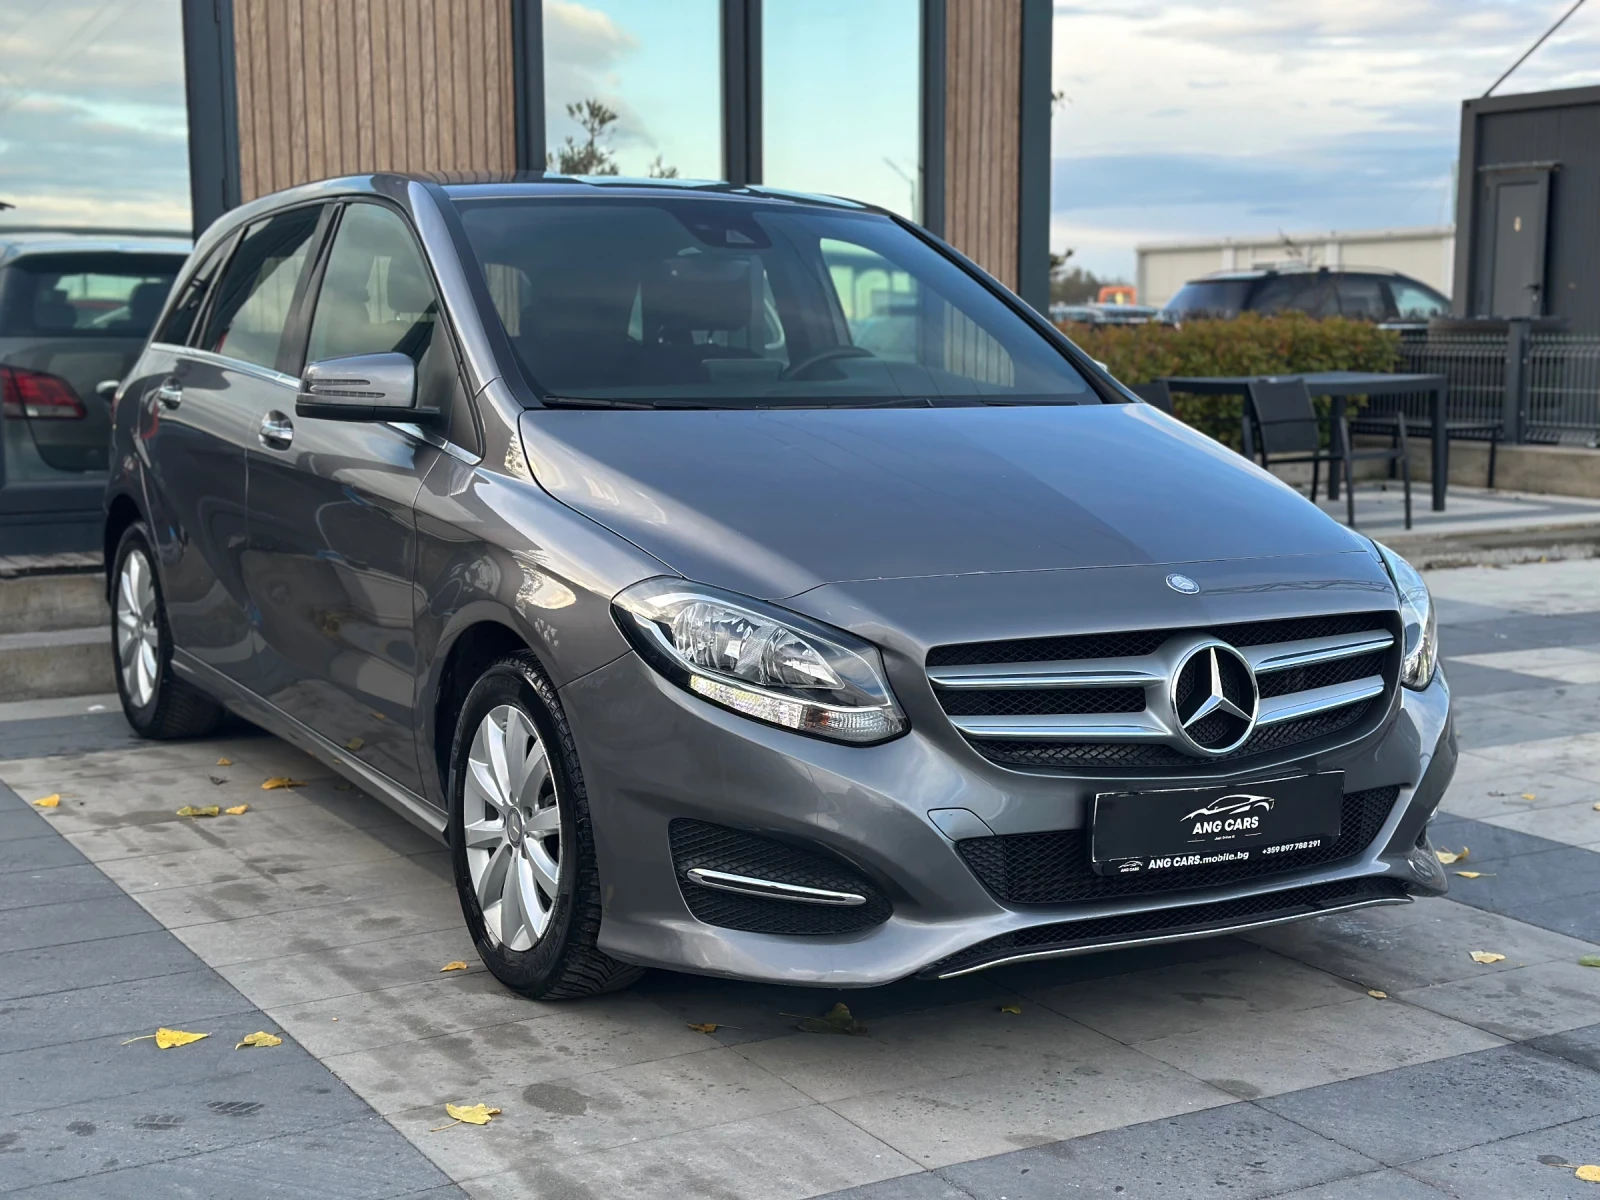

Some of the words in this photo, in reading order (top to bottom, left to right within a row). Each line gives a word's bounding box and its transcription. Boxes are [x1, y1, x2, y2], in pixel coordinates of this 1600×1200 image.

[1192, 820, 1222, 835] ANG
[1225, 816, 1259, 831] CARS
[1262, 846, 1280, 854] +359
[1280, 844, 1294, 852] 897
[1308, 840, 1321, 848] 291
[1148, 858, 1172, 870] ANG
[1173, 852, 1249, 866] CARS.mobile.bg
